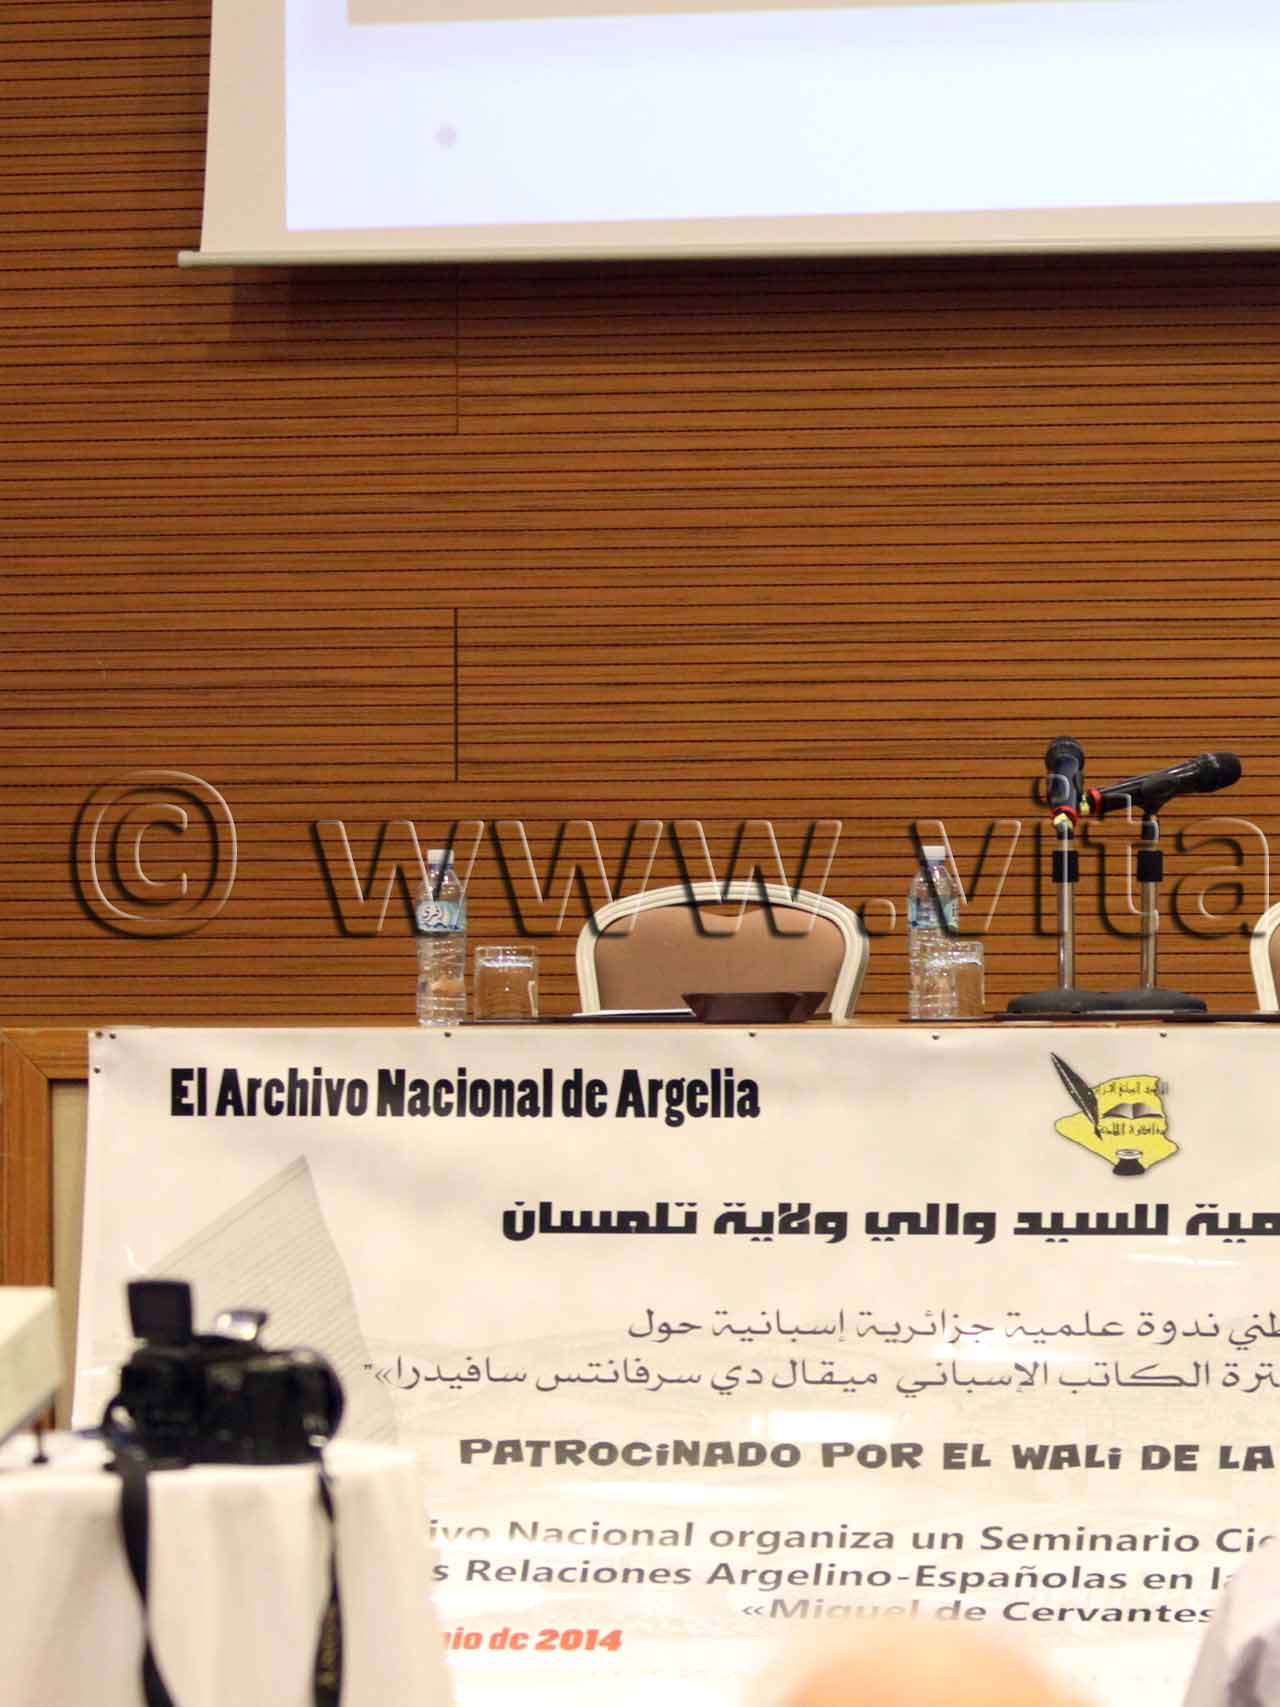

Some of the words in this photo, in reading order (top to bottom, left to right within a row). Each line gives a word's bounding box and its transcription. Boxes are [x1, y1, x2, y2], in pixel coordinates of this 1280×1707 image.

[171, 1067, 207, 1116] El
[216, 1067, 367, 1117] Archivo
[376, 1067, 553, 1118] Nacional
[562, 1068, 607, 1117] de
[616, 1068, 760, 1127] Argelia
[503, 1201, 698, 1242] تلمسان
[713, 1202, 849, 1244] ولاية
[865, 1203, 997, 1244] والي
[1014, 1203, 1169, 1243] للسيد
[628, 1308, 702, 1344] حول
[712, 1309, 845, 1344] إسبانية
[857, 1309, 995, 1344] جزائرية
[1006, 1310, 1124, 1345] علمية
[1137, 1312, 1220, 1346] ندوة
[536, 1358, 702, 1392] سرفانتس
[711, 1364, 764, 1396] دي
[772, 1359, 878, 1393] ميقال
[896, 1360, 1048, 1398] الإسباني
[1059, 1361, 1210, 1394] الكاتب
[822, 1442, 923, 1469] POR
[943, 1443, 991, 1470] EL
[1141, 1444, 1199, 1471] DE
[1219, 1444, 1275, 1471] LA
[429, 1519, 490, 1541] ivo
[509, 1521, 695, 1549] Nacional
[710, 1523, 894, 1556] organiza
[912, 1531, 963, 1551] un
[980, 1525, 1200, 1553] Seminario
[432, 1564, 449, 1582] s
[466, 1558, 691, 1584] Relaciones
[706, 1562, 1127, 1594] Argelino-Españolas
[1143, 1573, 1193, 1590] en
[936, 1600, 987, 1621] de
[534, 1628, 622, 1651] 2014
